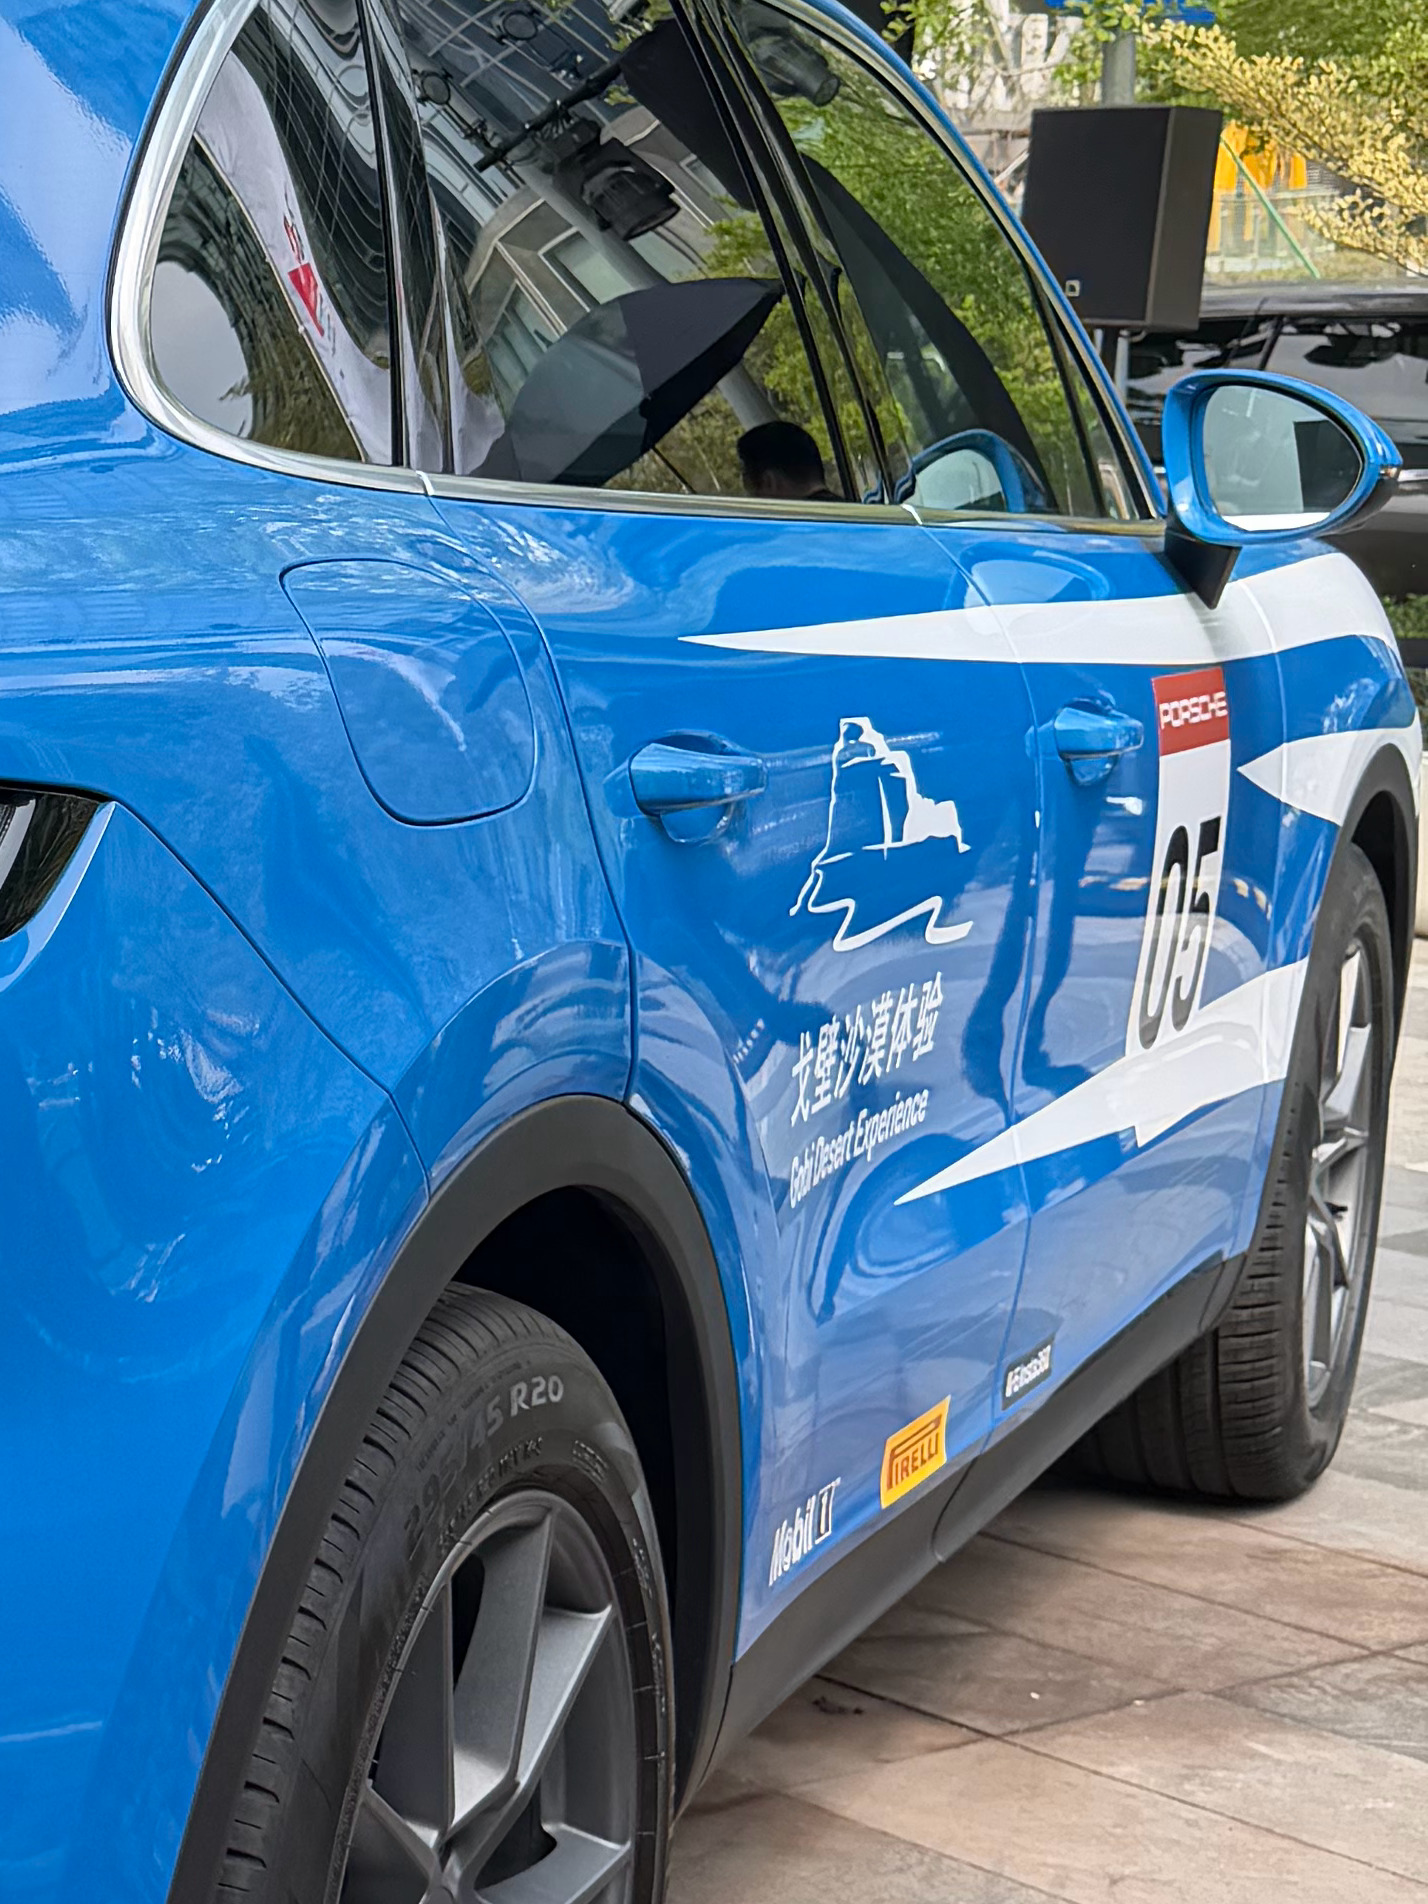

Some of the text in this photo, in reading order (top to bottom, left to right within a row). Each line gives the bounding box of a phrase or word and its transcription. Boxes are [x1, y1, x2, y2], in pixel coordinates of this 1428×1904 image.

[1158, 690, 1229, 731] PORSCHE
[1138, 815, 1222, 1050] 05
[790, 970, 944, 1128] 戈壁沙漠体验
[789, 1087, 930, 1210] Gobi Desert Experience
[509, 1374, 565, 1418] R20
[886, 1413, 943, 1492] PIRELLI
[768, 1493, 817, 1588] Mobil
